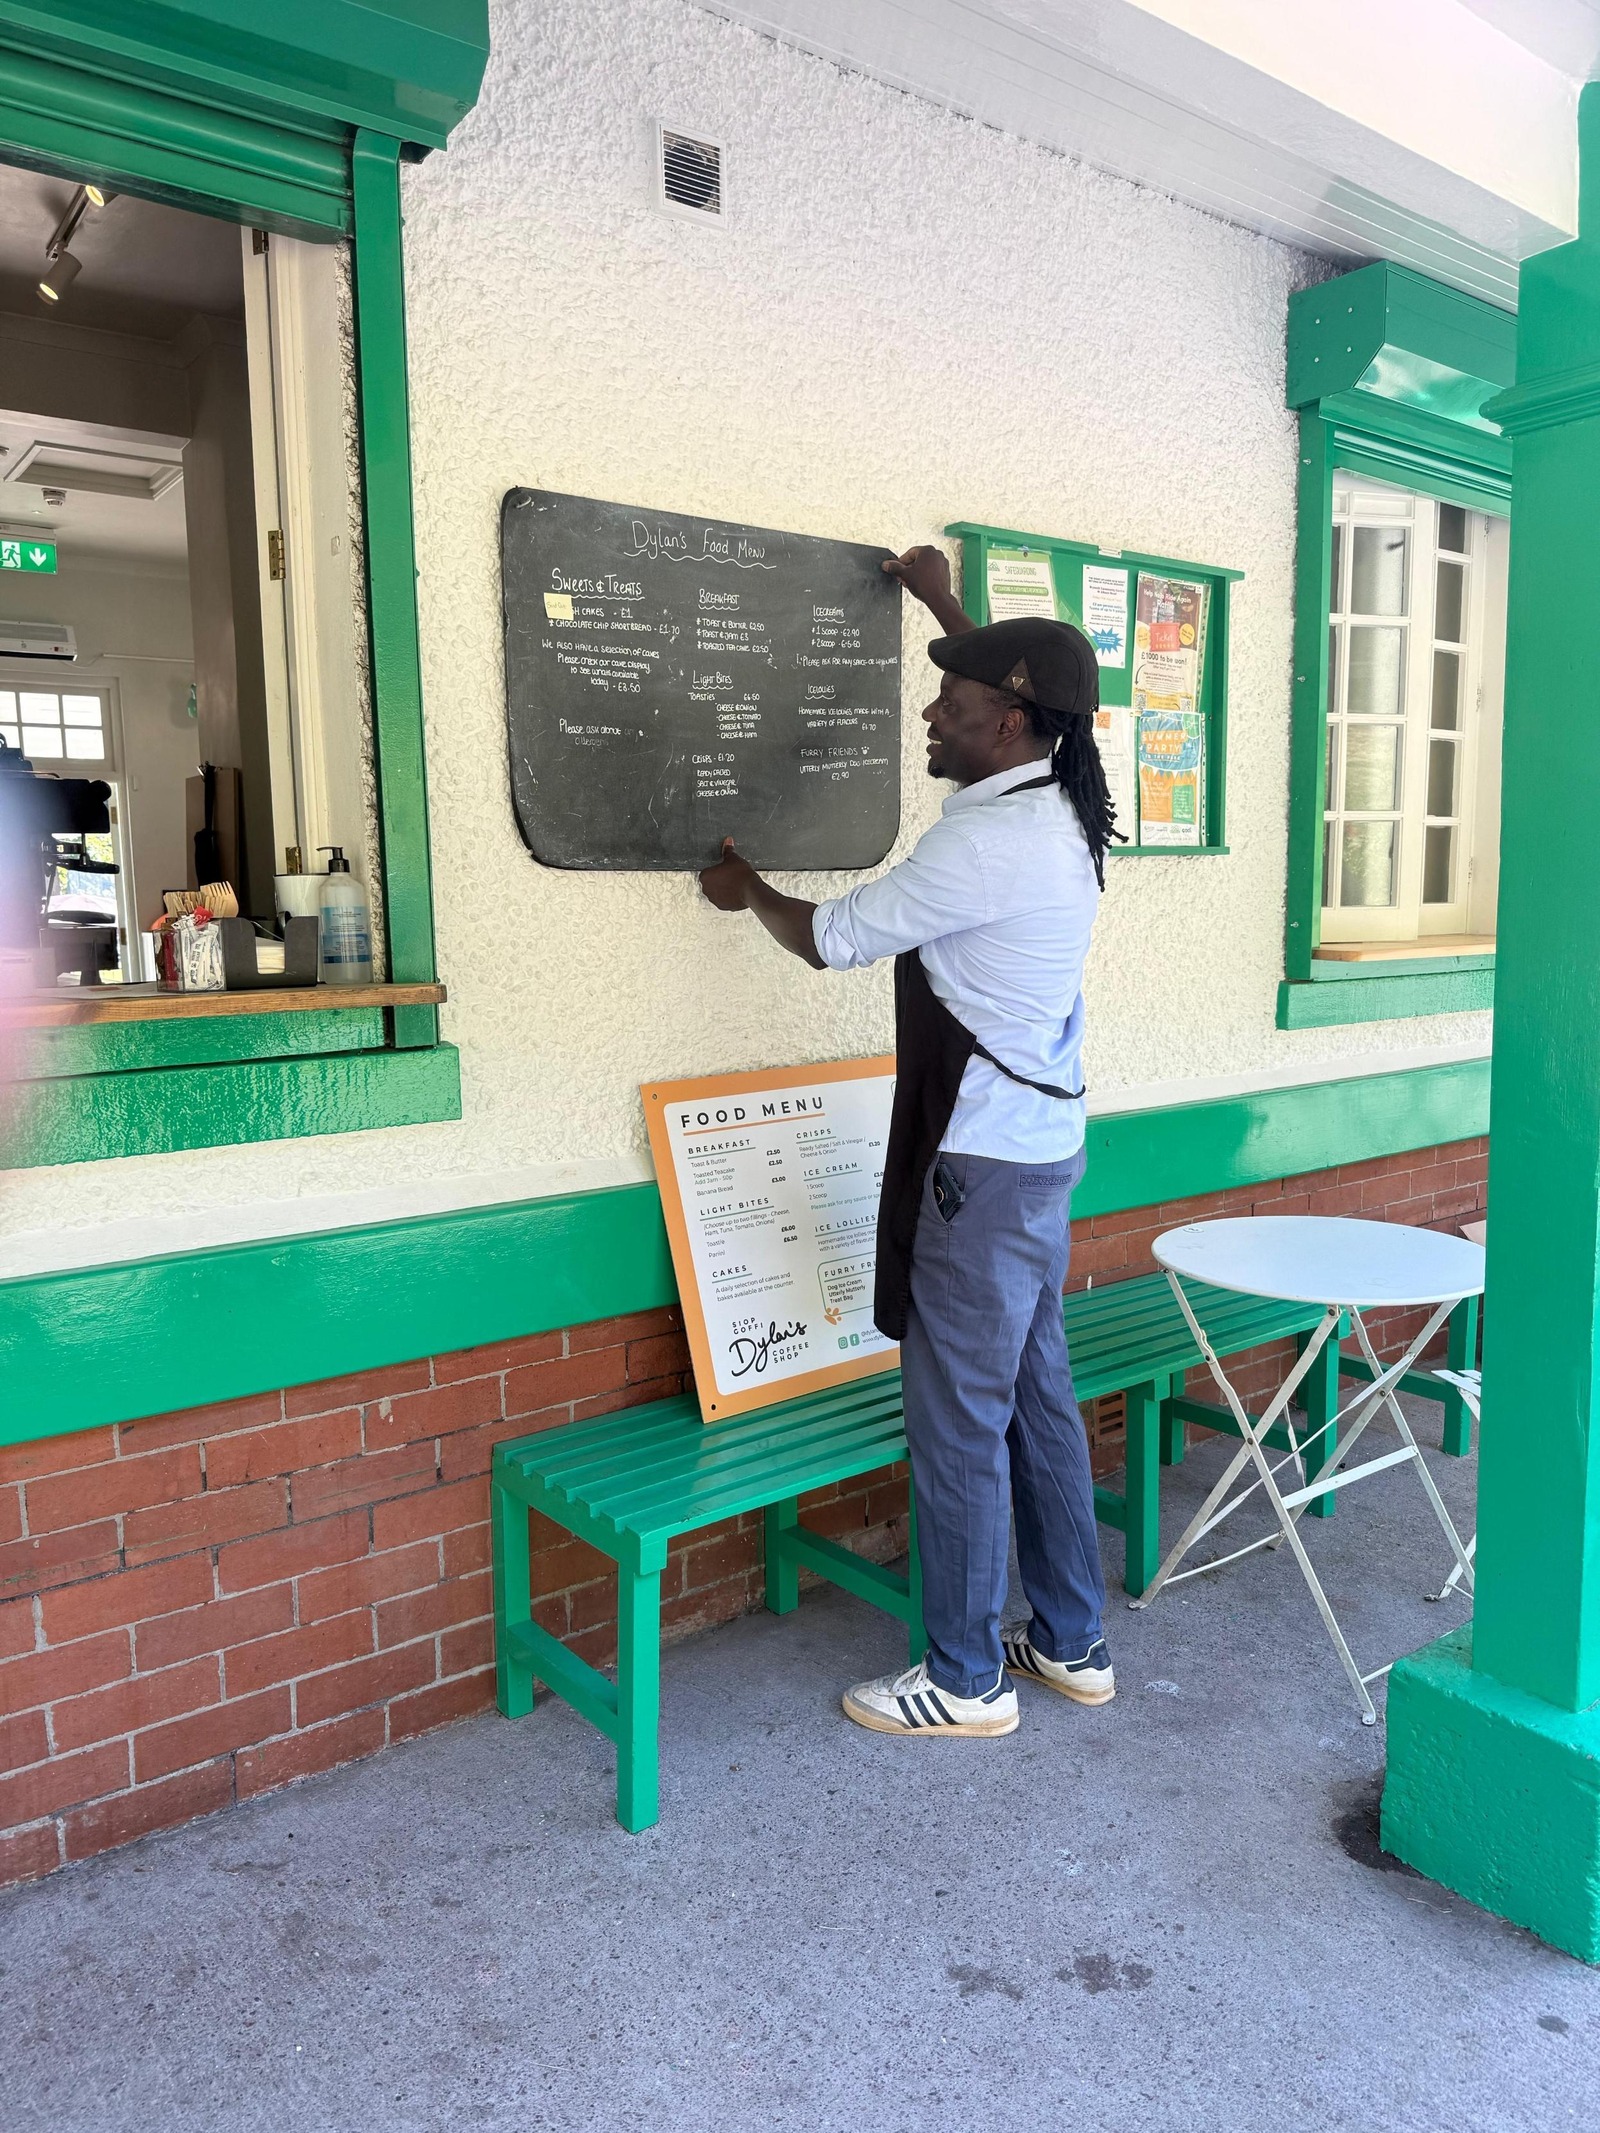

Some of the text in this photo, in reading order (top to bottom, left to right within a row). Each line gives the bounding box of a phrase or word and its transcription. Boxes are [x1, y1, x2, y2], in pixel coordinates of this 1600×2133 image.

[632, 521, 687, 559] Dylan's
[703, 528, 728, 555] Food
[582, 608, 604, 617] CAKES
[621, 608, 633, 618] £1
[556, 619, 592, 629] CHOCOLATE
[702, 618, 721, 627] TOAST
[702, 630, 719, 638] TOAST
[557, 642, 572, 650] ALSO
[601, 645, 632, 656] selection
[633, 648, 641, 656] of
[558, 653, 580, 664] Please
[591, 677, 608, 691] today
[560, 718, 585, 734] Please
[586, 726, 599, 734] ask
[801, 748, 858, 757] FURRY FRIENDS
[681, 1097, 823, 1128] FOOD MENU
[796, 1128, 831, 1138] CRISPS
[688, 1139, 750, 1154] BREAKFAST
[693, 1170, 713, 1178] Toasted
[715, 1167, 735, 1175] Teacake
[826, 1163, 857, 1173] CREAM
[697, 1188, 717, 1196] Banana
[700, 1198, 769, 1215] LIGHT BITES
[815, 1215, 875, 1232] ICE LOLLIES
[709, 1250, 725, 1258] Panini
[712, 1265, 747, 1278] CAKES
[825, 1265, 855, 1277] FURRY
[734, 1280, 758, 1289] selection
[717, 1293, 733, 1301] bakes
[734, 1288, 757, 1297] available
[732, 1317, 755, 1327] SIOP
[734, 1323, 763, 1334] COFFI
[729, 1321, 807, 1377] Dylan's
[773, 1342, 809, 1356] COFFEE
[774, 1352, 798, 1363] SHOP
